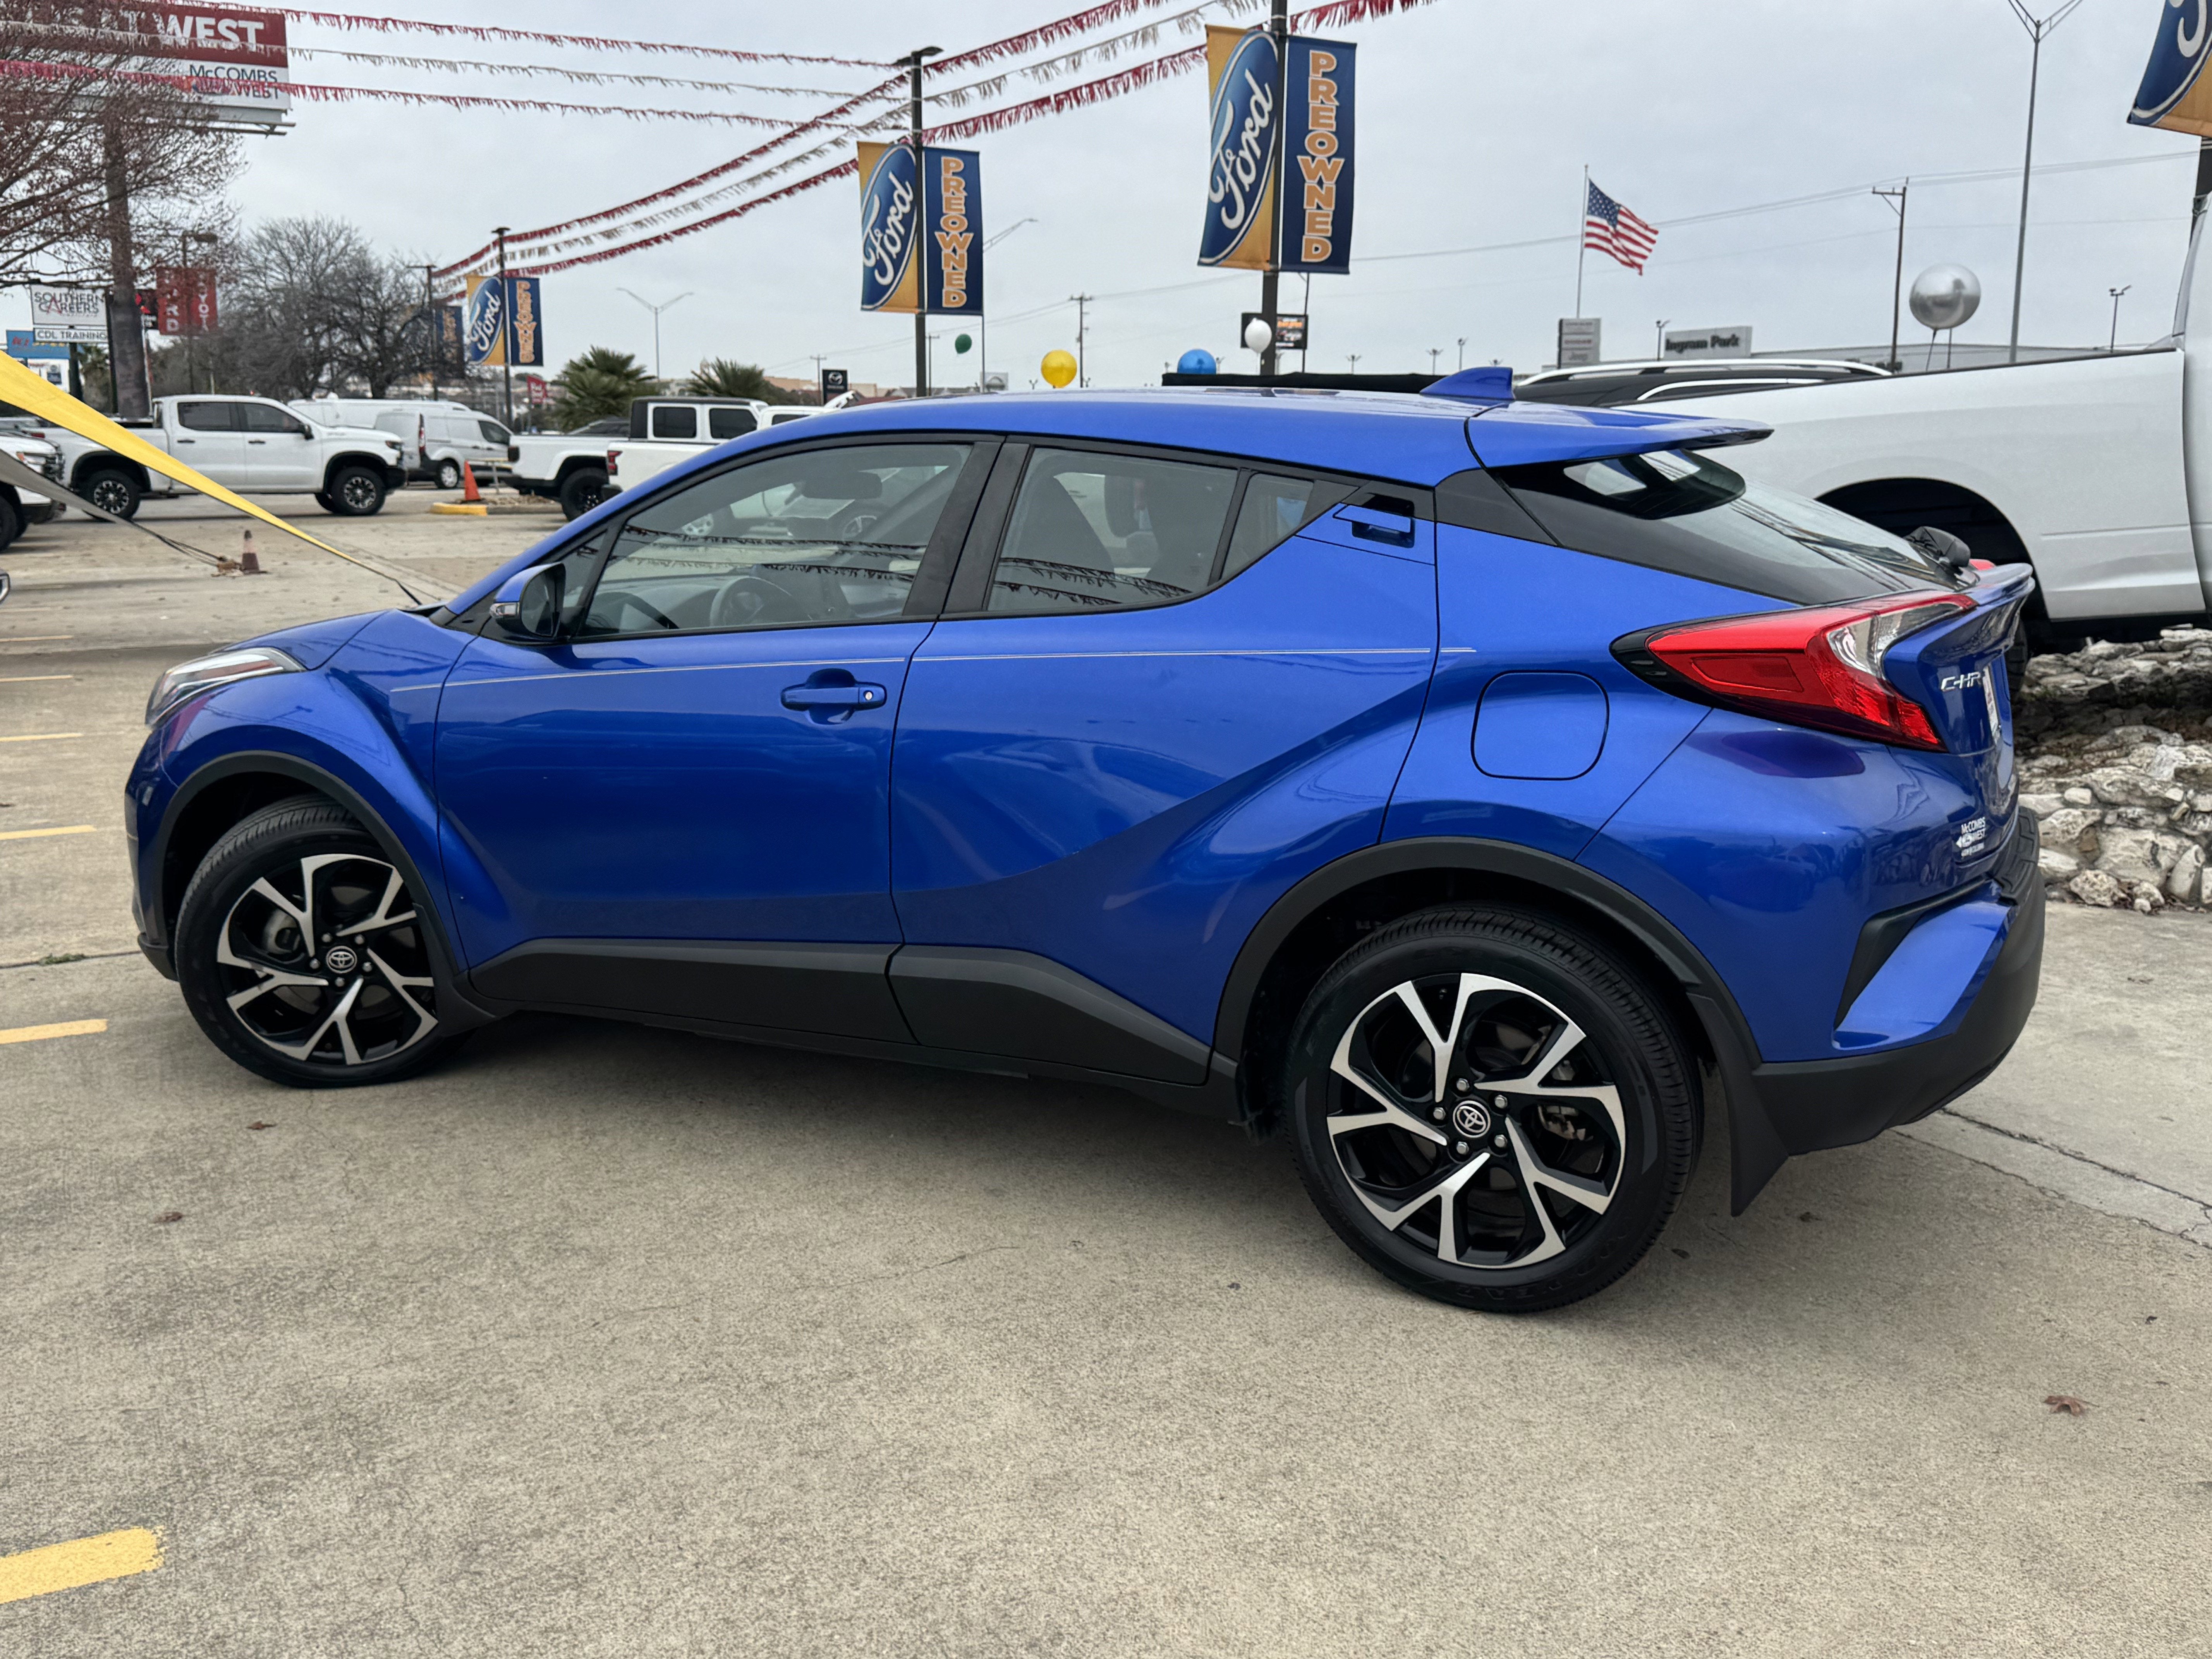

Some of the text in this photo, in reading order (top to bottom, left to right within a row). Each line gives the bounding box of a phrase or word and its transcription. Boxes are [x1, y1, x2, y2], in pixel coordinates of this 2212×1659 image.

[153, 13, 264, 52] WEST
[189, 64, 278, 82] McCOMBS
[1209, 68, 1273, 229] Ford
[1297, 50, 1345, 263] PREOWNED
[863, 171, 914, 286] Ford
[934, 155, 974, 307] PREOWNED
[34, 291, 104, 303] SOUTHERN
[39, 295, 100, 314] CAREERS
[198, 271, 210, 332] OYOTA
[38, 330, 107, 340] CDL TRAINING
[470, 290, 501, 352] Ford
[1665, 333, 1739, 354] Ingram Park
[1941, 672, 1982, 692] C-HR
